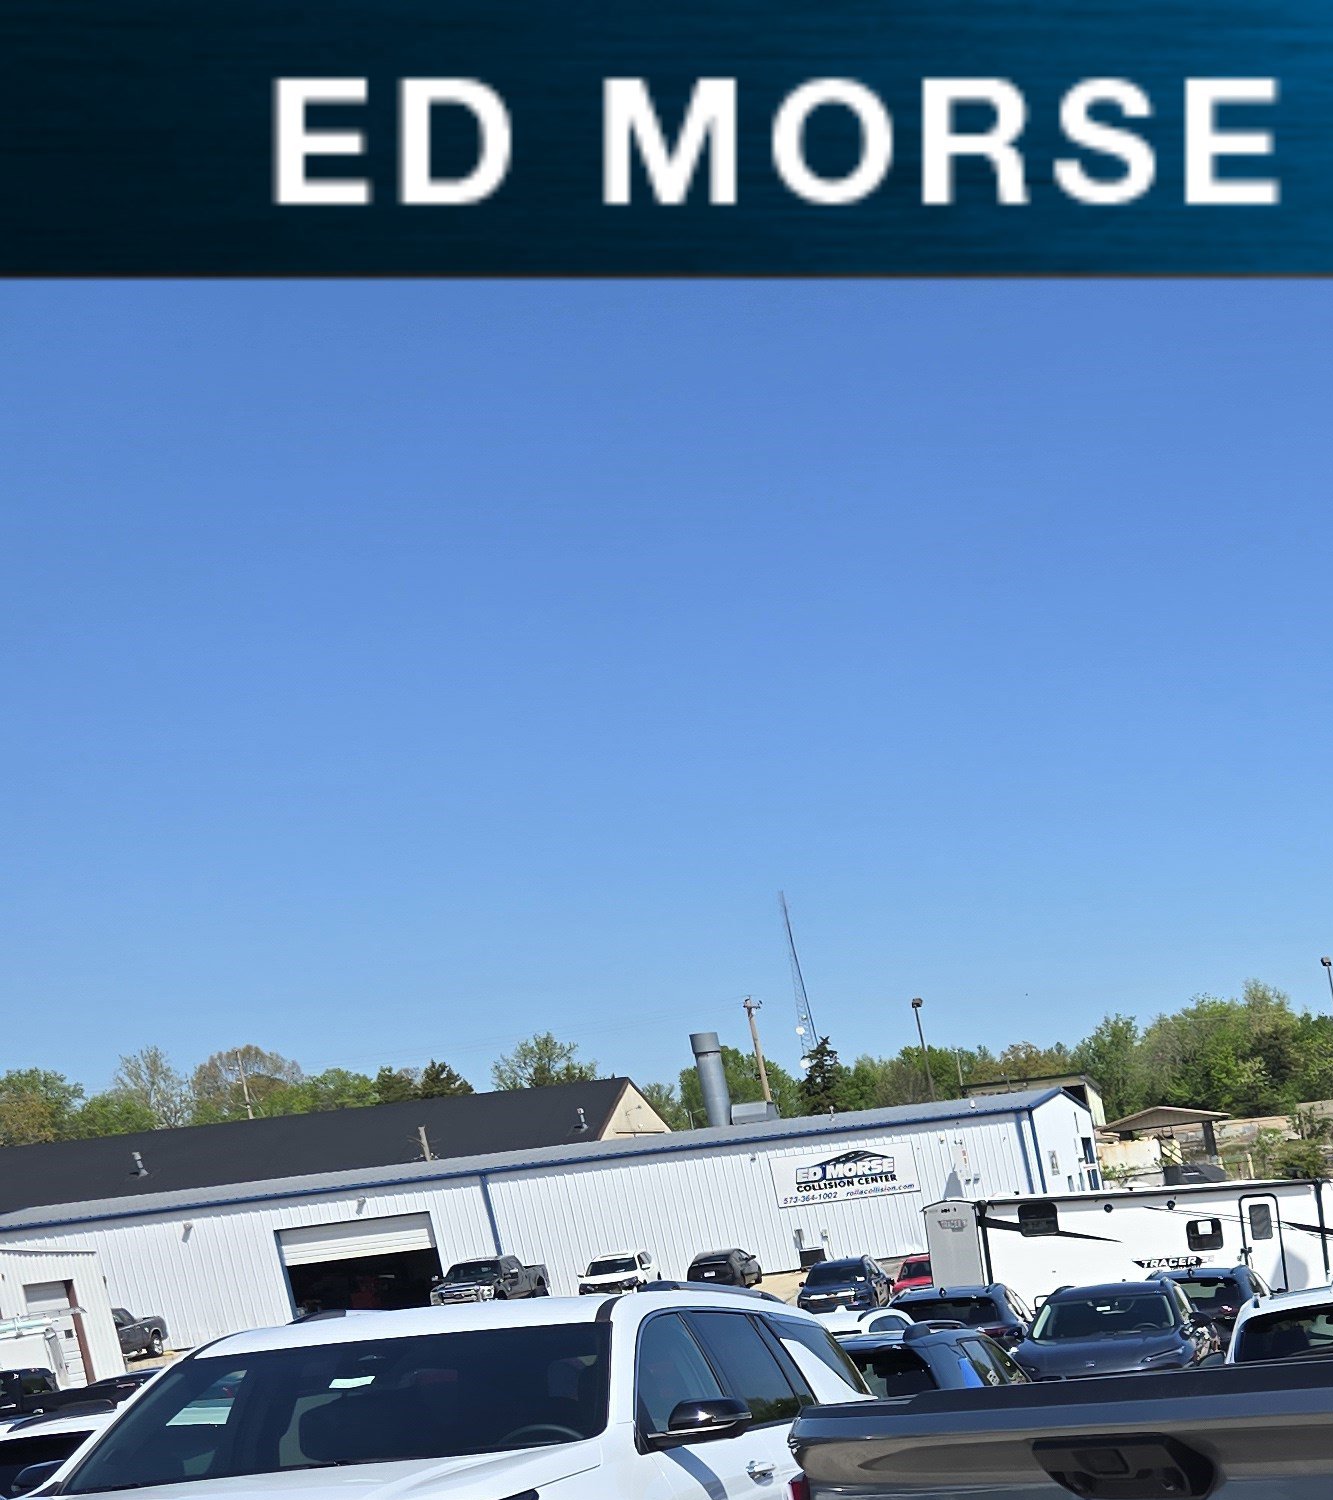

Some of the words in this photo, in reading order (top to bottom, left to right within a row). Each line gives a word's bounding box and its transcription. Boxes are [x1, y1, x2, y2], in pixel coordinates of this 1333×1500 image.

[796, 1168, 822, 1183] ED
[825, 1157, 894, 1180] MORSE
[783, 1191, 838, 1204] 573-364-1002
[846, 1183, 914, 1197] rollacollision.com
[796, 1179, 854, 1193] COLLISION
[858, 1174, 897, 1186] CENTER
[1141, 1256, 1197, 1268] TRACER
